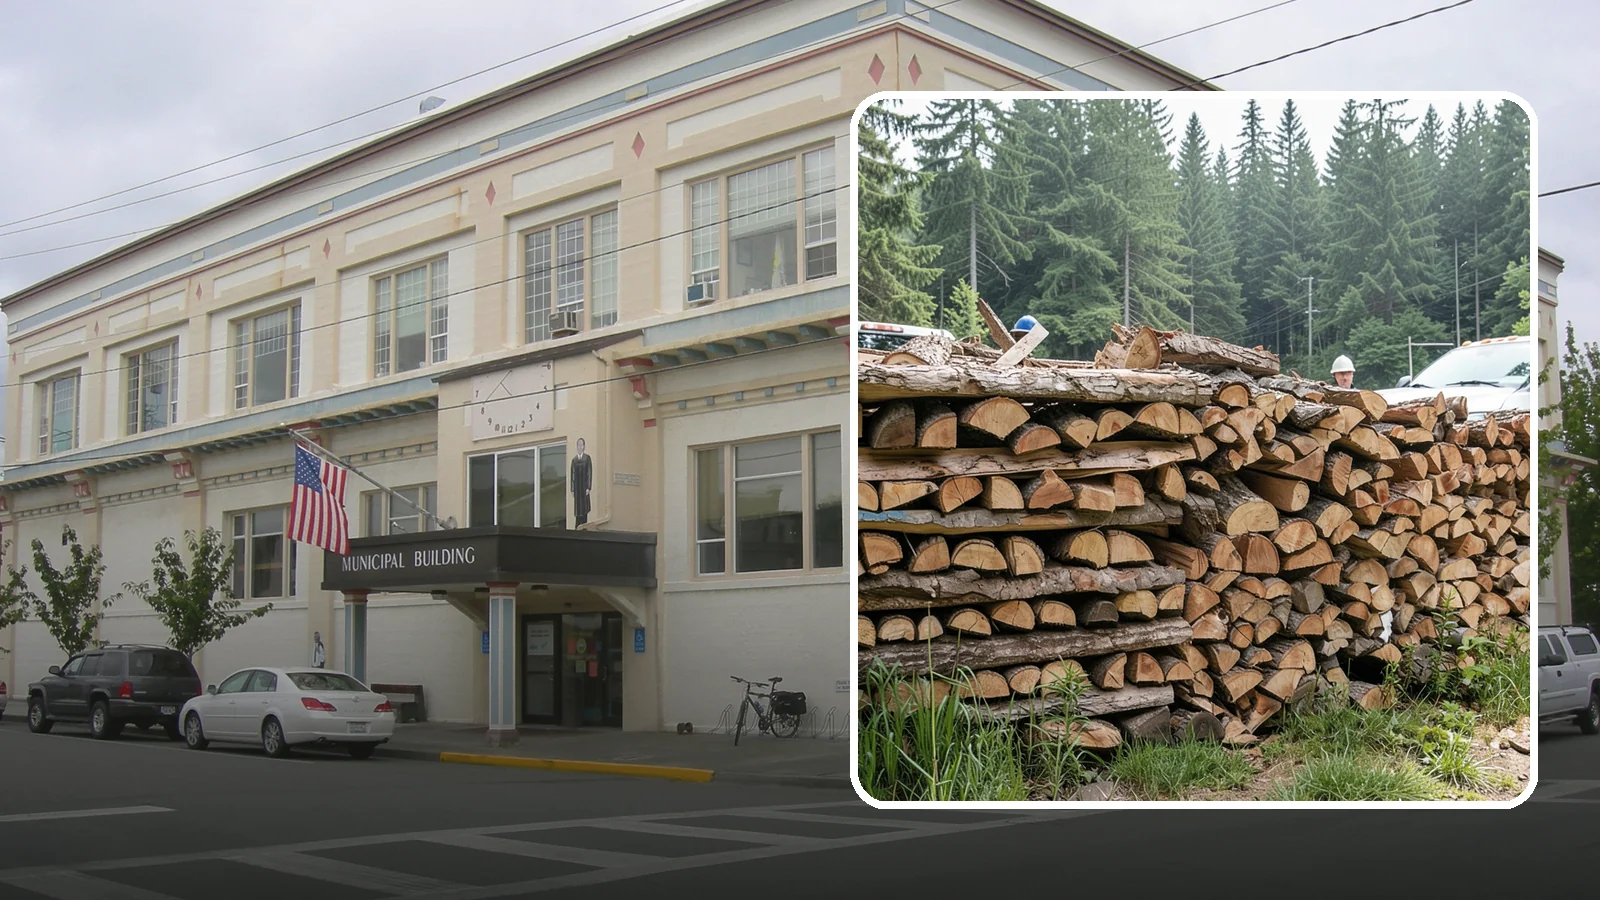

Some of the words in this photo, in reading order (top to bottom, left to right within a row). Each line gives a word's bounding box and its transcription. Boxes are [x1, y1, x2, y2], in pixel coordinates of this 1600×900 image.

[495, 423, 500, 432] 10
[507, 425, 514, 433] 12
[342, 552, 405, 572] MUNICIPAL
[414, 546, 475, 567] BUILDING
